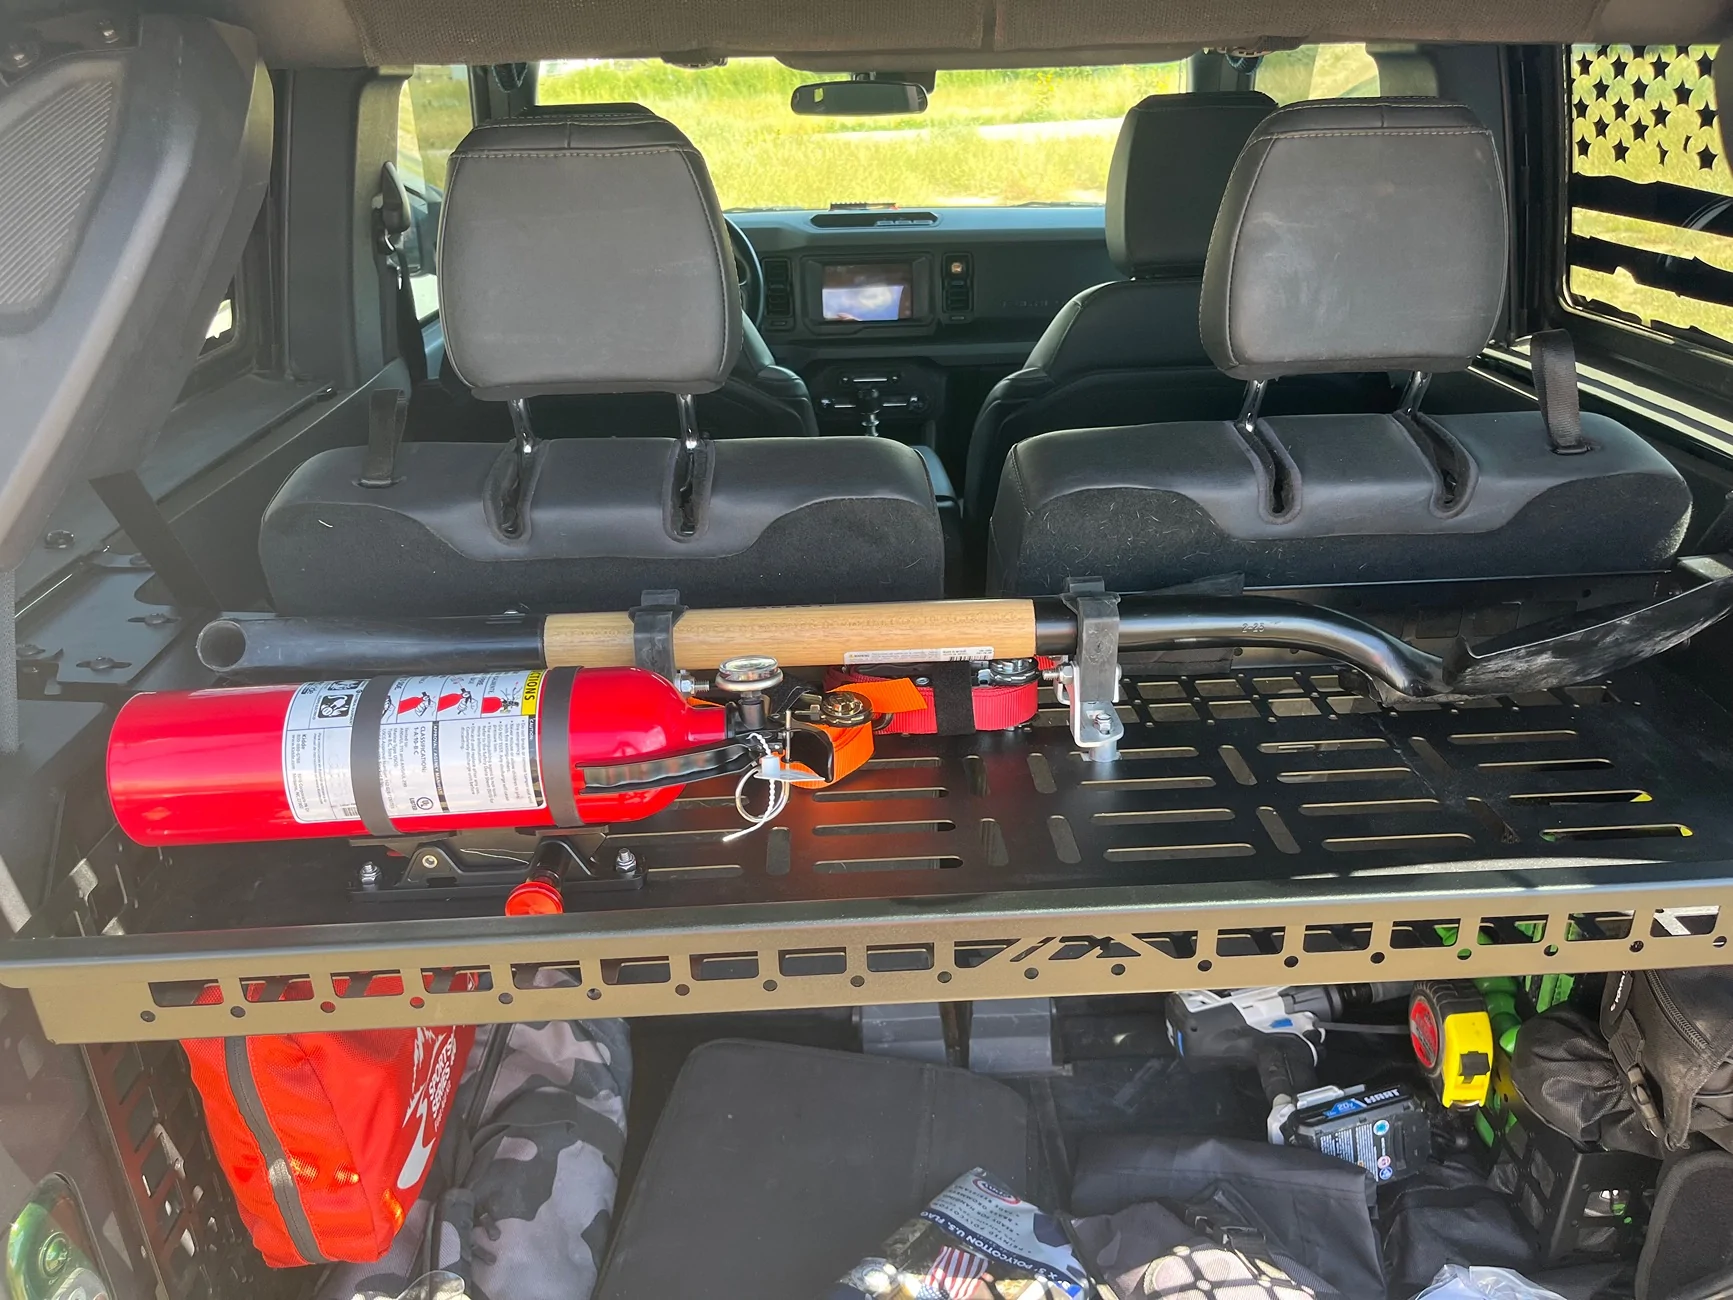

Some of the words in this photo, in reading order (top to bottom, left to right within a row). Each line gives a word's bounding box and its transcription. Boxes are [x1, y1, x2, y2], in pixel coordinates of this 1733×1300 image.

[429, 1038, 452, 1101] SPORTS
[432, 1061, 451, 1119] SERIES
[1364, 1088, 1400, 1104] HART
[921, 1211, 946, 1224] FLAG
[947, 1221, 966, 1239] U.S.
[966, 1235, 1033, 1269] POLYCOTTON
